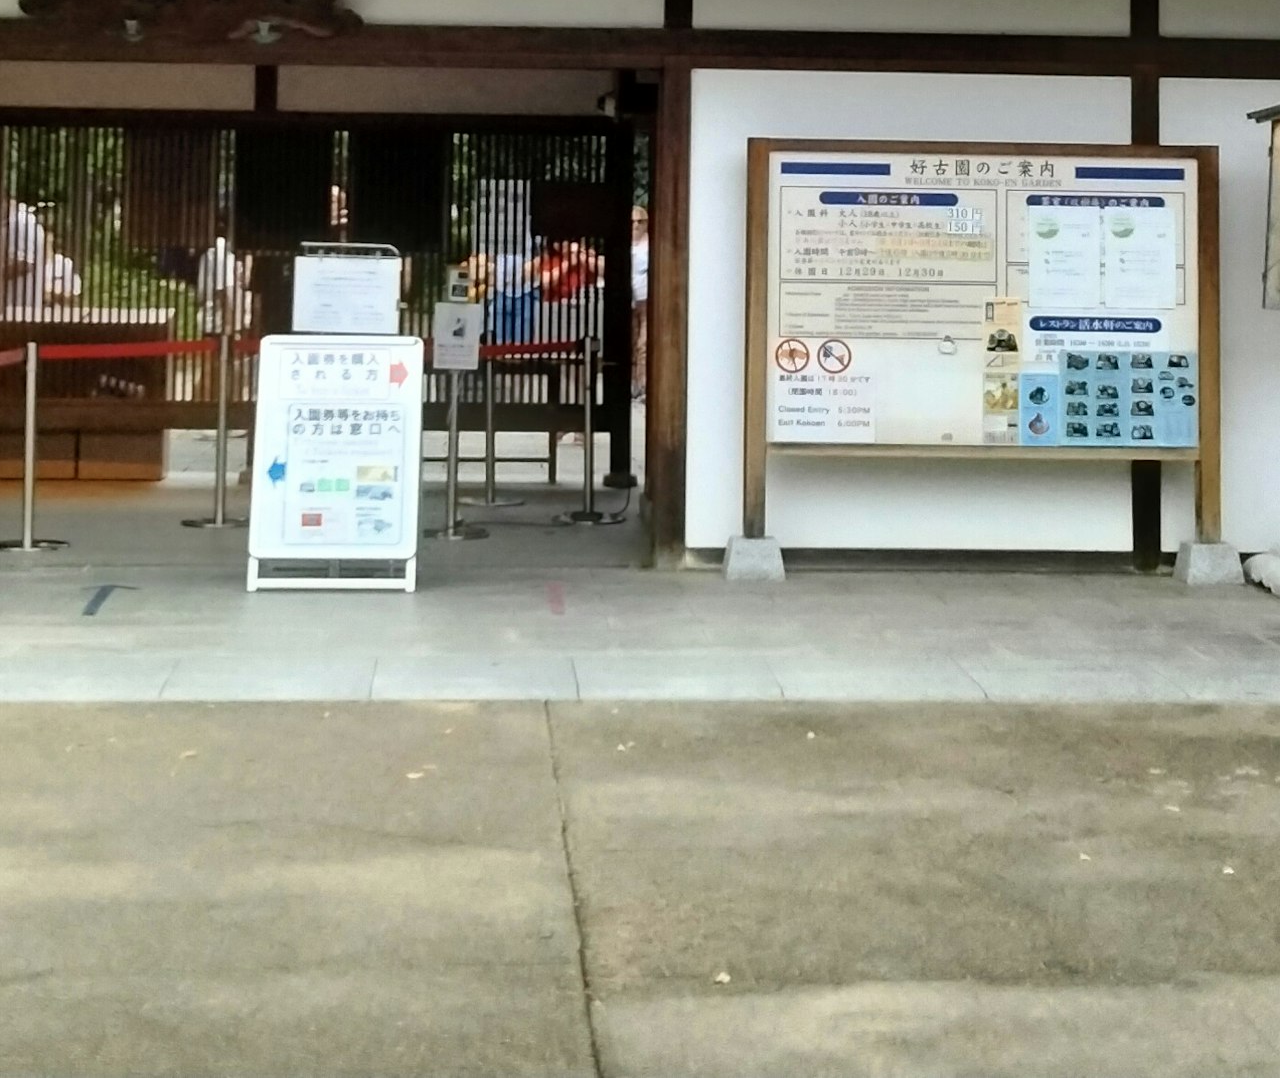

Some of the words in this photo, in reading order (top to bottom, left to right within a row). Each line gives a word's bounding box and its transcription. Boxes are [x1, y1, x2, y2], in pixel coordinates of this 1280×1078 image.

[909, 158, 1056, 178] 好古園のご案内
[904, 177, 952, 186] WELCOME
[956, 178, 969, 186] TO
[1021, 179, 1062, 187] GARDEN
[856, 193, 920, 205] 入園のご案内
[291, 352, 380, 366] 入園券を購入
[291, 369, 379, 381] される方
[292, 422, 401, 436] の方は窓口へ
